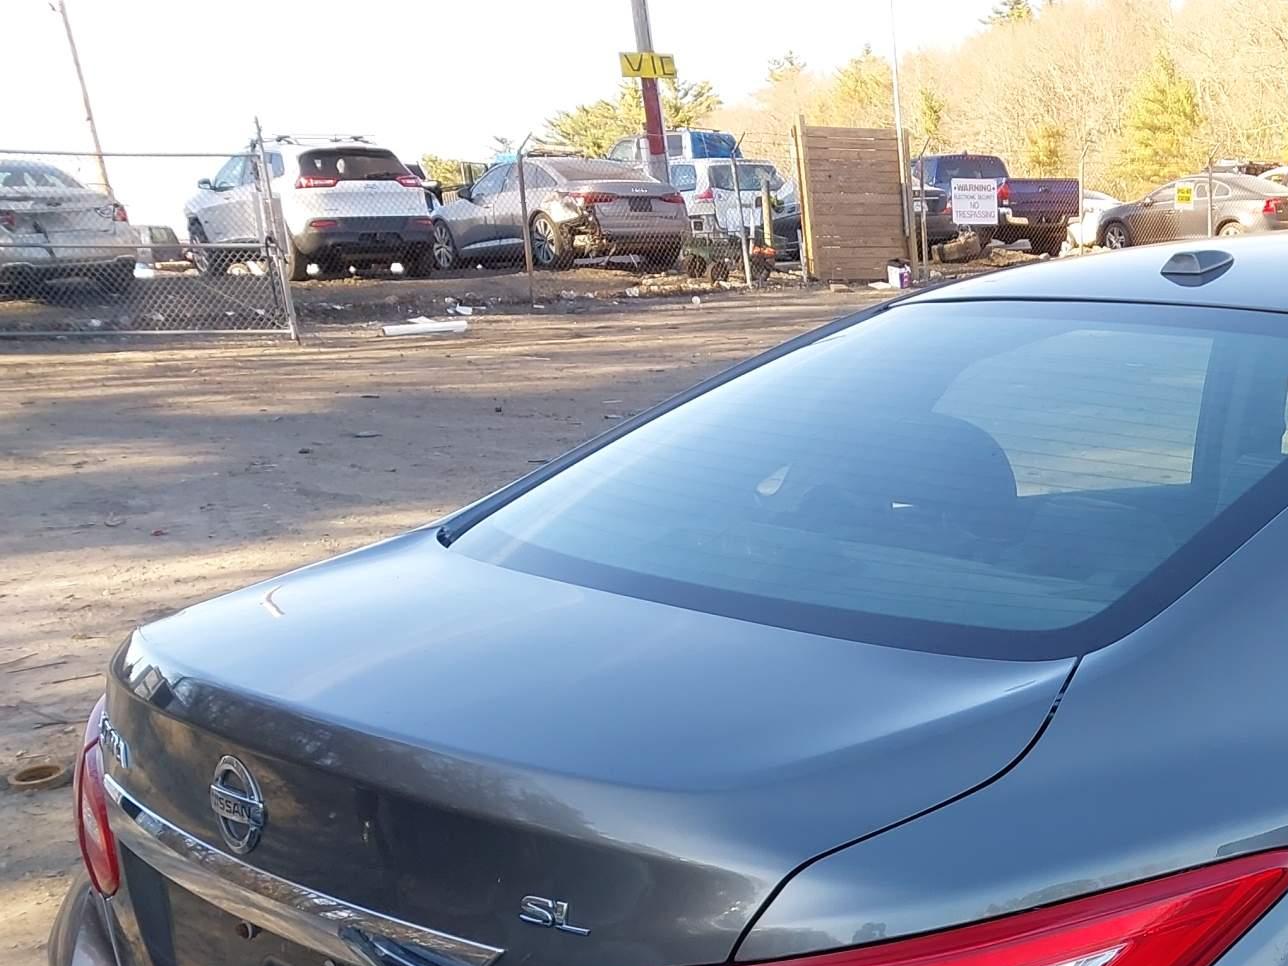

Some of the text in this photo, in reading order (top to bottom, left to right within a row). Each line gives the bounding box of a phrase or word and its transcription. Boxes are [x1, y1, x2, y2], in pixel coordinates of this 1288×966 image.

[956, 183, 992, 192] WARNING
[969, 201, 980, 209] NO
[956, 210, 995, 219] TRESPASSING
[516, 893, 592, 936] SL
